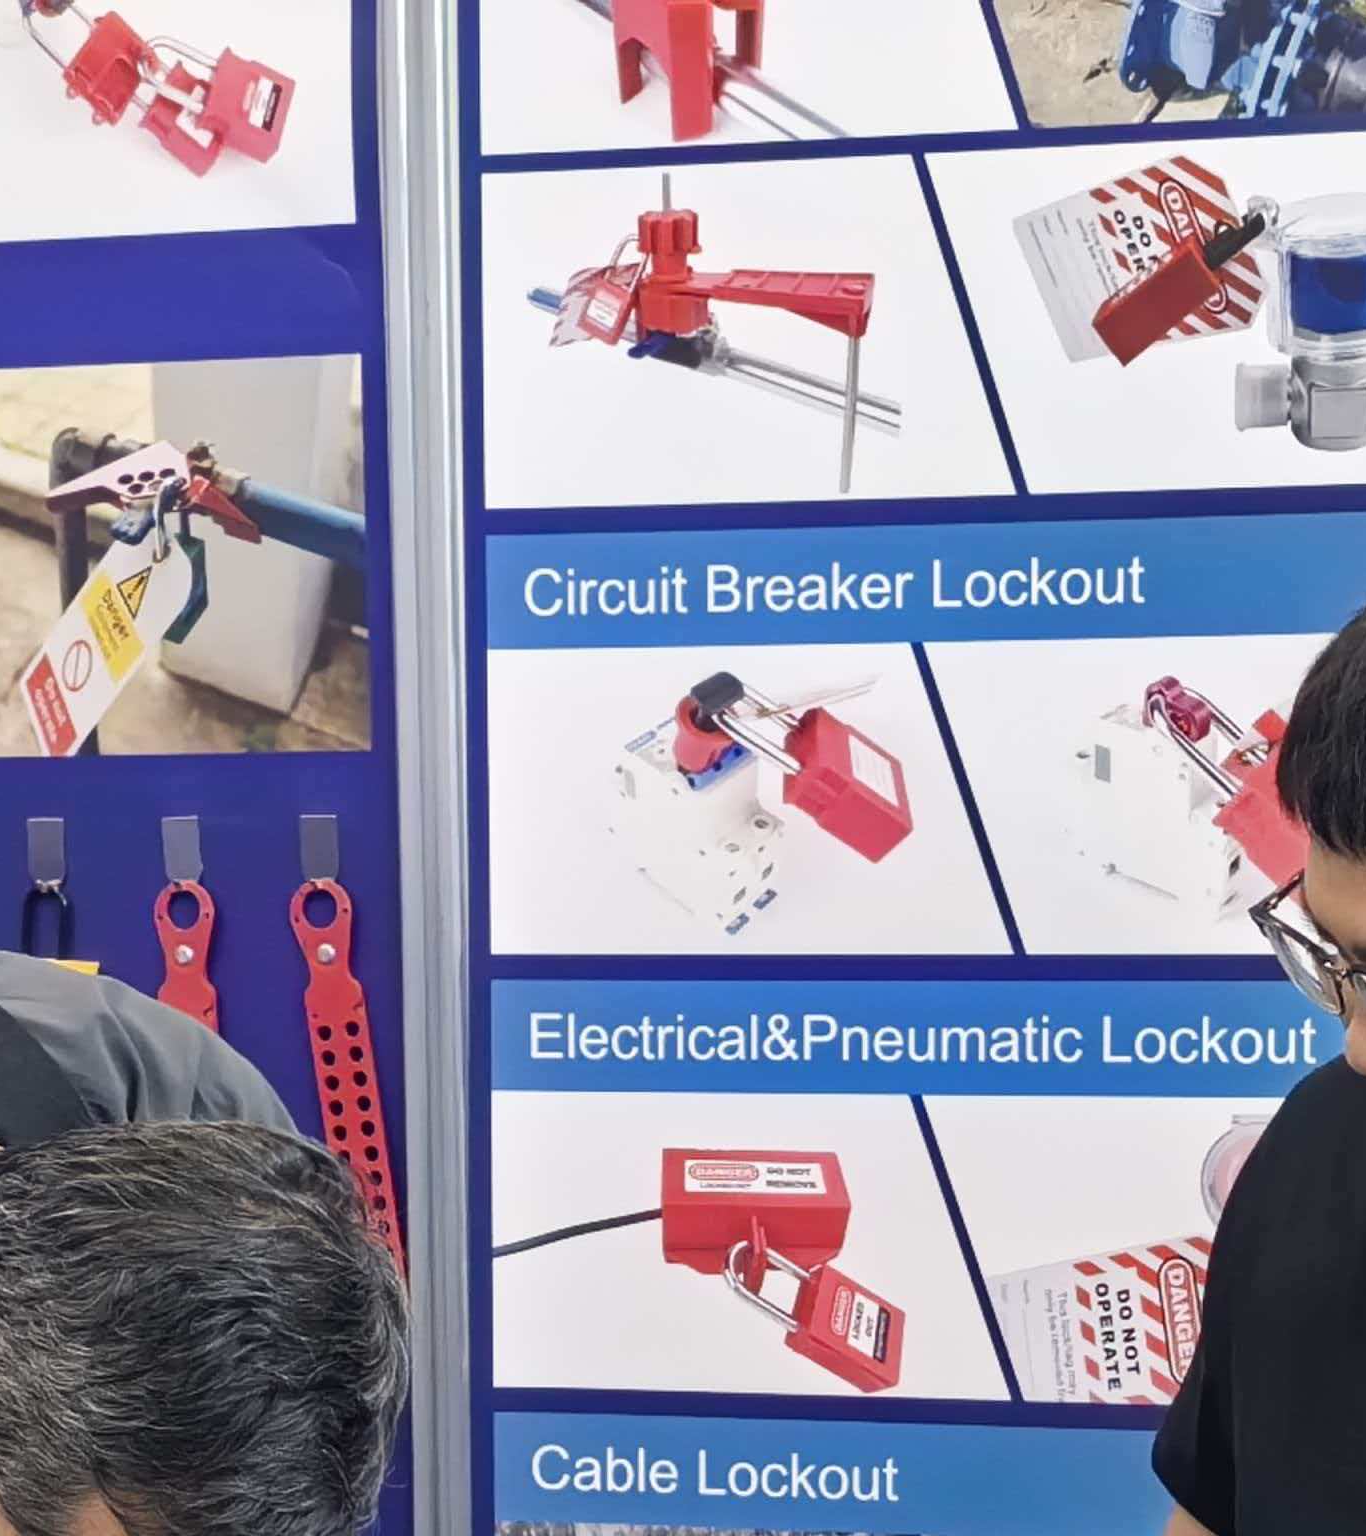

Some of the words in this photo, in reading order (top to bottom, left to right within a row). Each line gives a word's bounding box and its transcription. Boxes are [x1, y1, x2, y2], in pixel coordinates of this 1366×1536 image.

[1114, 209, 1146, 272] OPER
[523, 567, 688, 617] Circuit
[706, 562, 915, 614] Breaker
[932, 556, 1146, 608] Lockout
[530, 1013, 1083, 1064] Electrical&Pneumatic
[1101, 1016, 1318, 1066] Lockout
[1117, 1289, 1133, 1320] DO
[1095, 1283, 1122, 1391] OPERATE
[1122, 1328, 1141, 1376] NOT
[532, 1444, 678, 1494] Cable
[698, 1449, 900, 1501] Lockout
